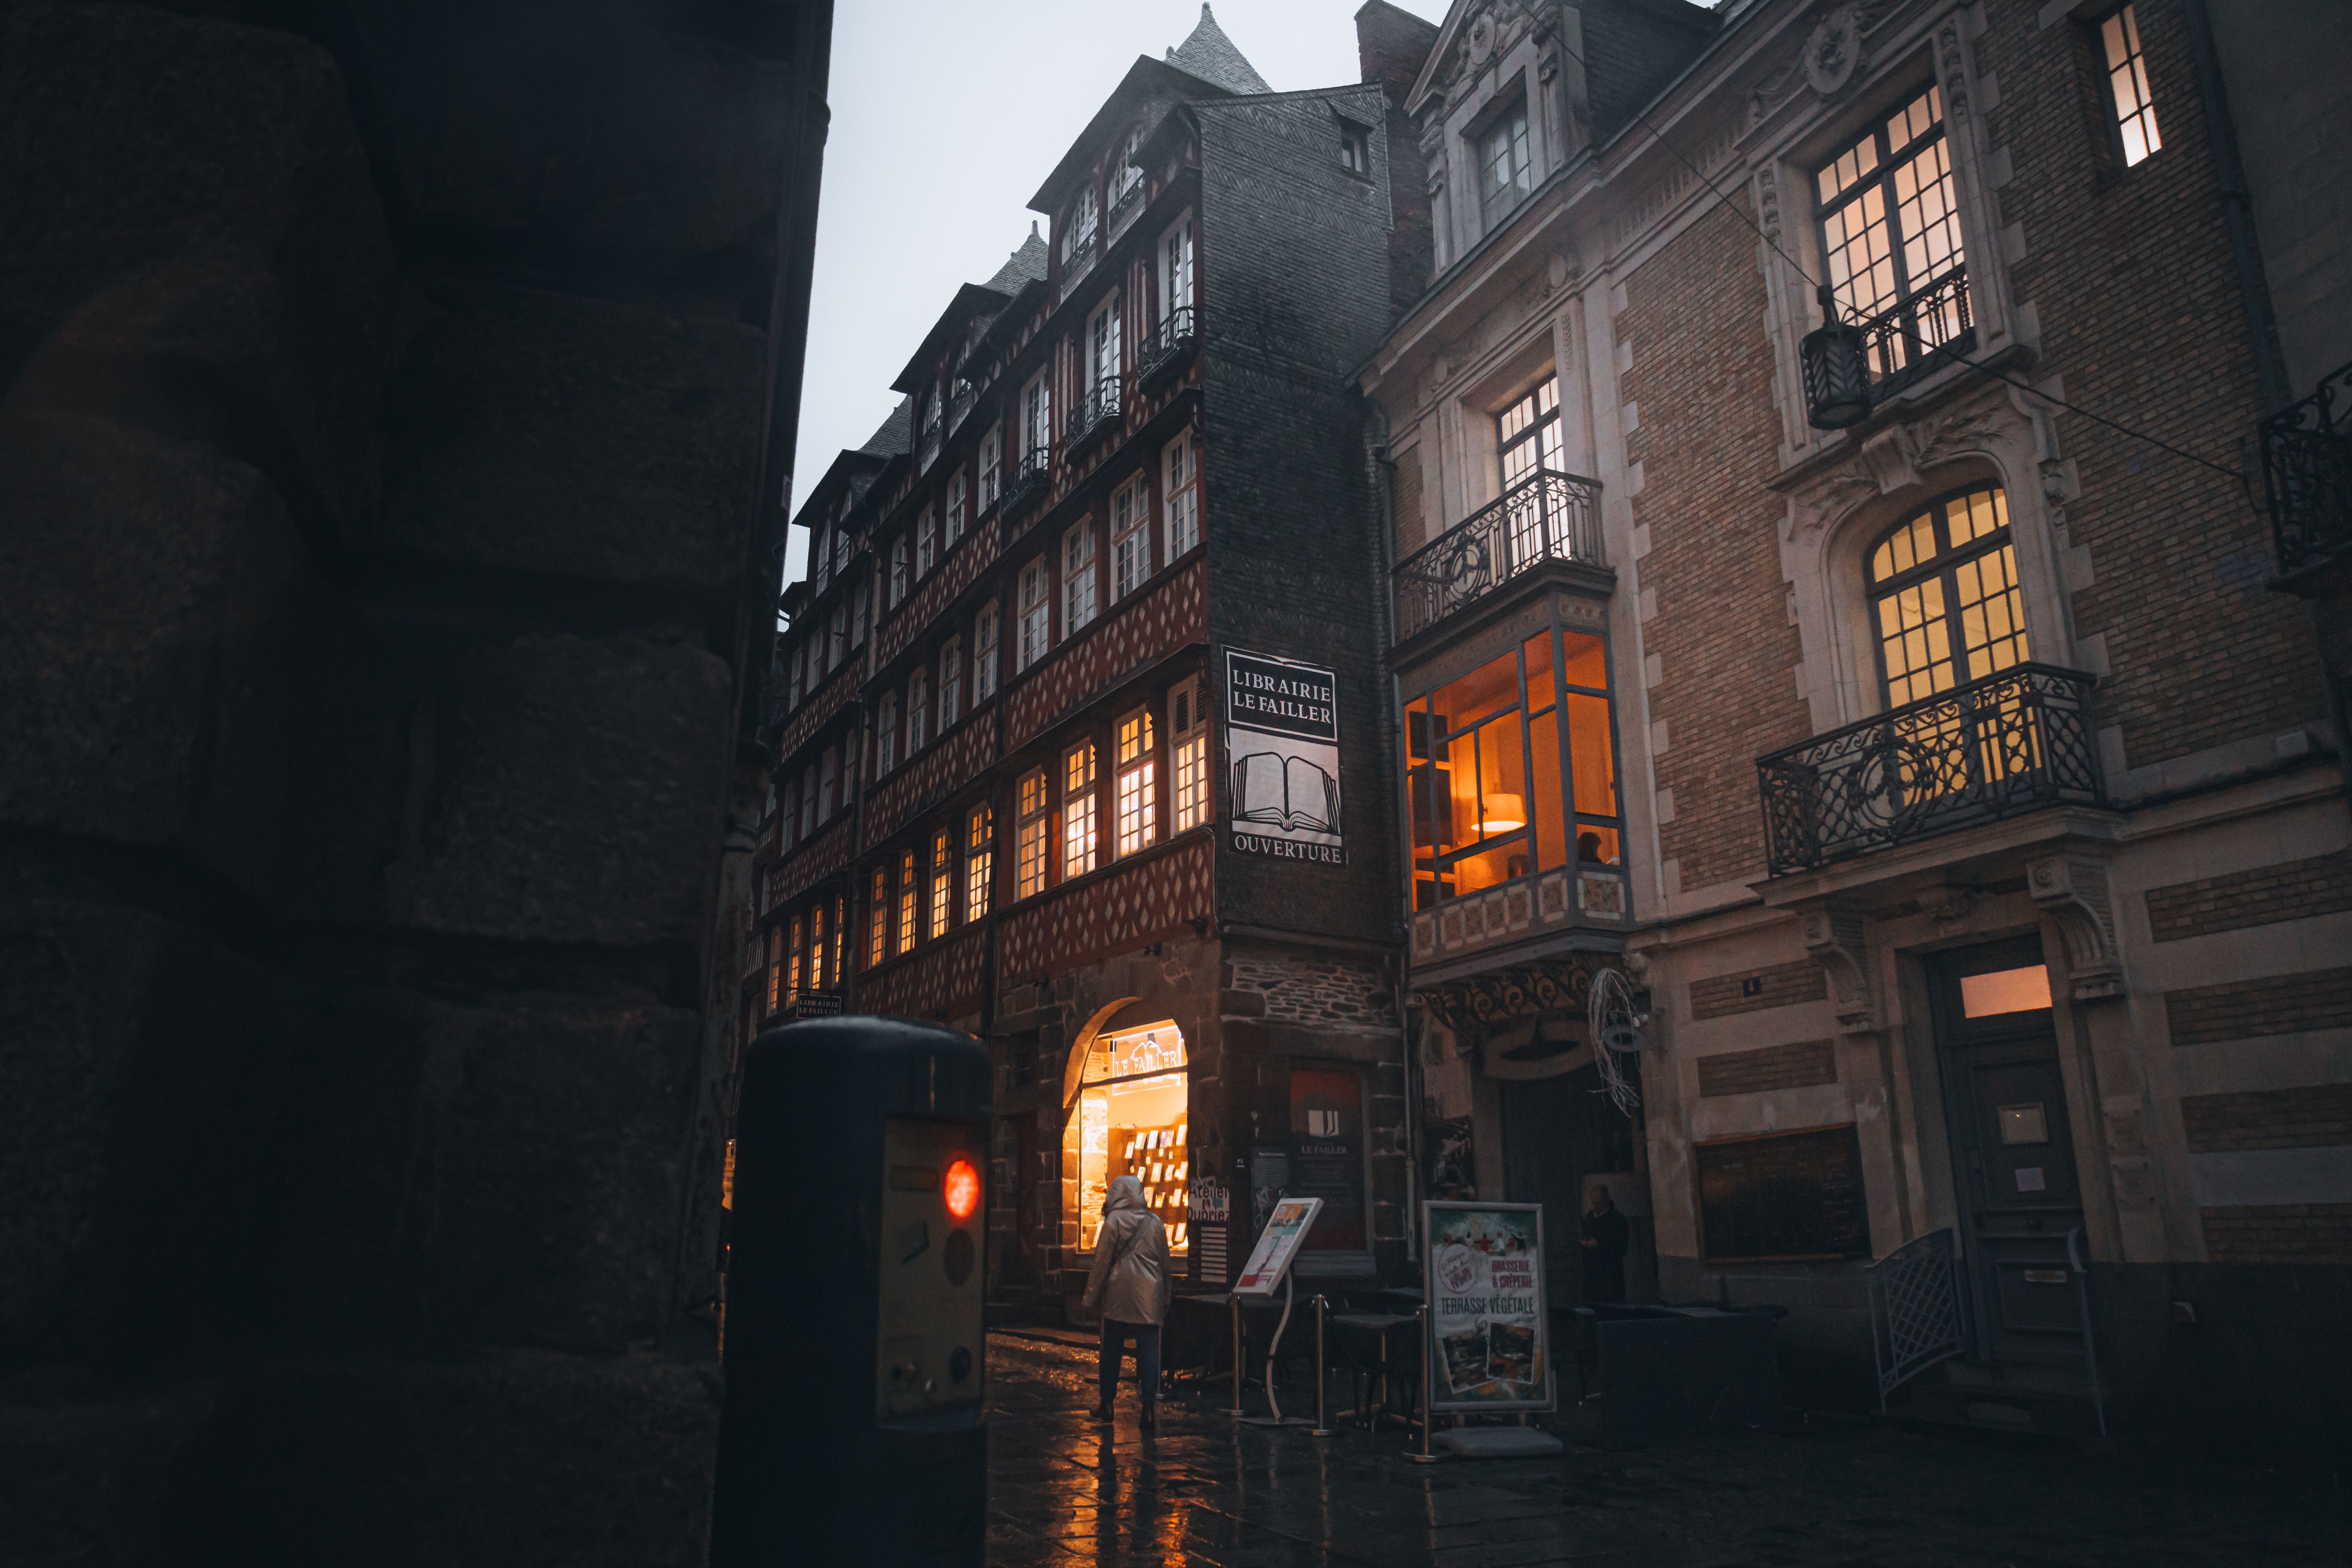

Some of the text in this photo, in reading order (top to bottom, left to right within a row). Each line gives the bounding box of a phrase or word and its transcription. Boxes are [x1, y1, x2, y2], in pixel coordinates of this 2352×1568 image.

[1233, 669, 1331, 702] LIBRAIRIE
[1233, 691, 1331, 724] LE FAILLER
[1234, 835, 1342, 863] OUVERTURE
[1115, 1051, 1178, 1076] LE FAILLER
[1302, 1146, 1313, 1154] LE
[1492, 1260, 1530, 1273] BRASSERIE
[1492, 1273, 1533, 1288] & CRÊPERIE
[1441, 1294, 1534, 1314] TERRASSE VÉGÉTALE
